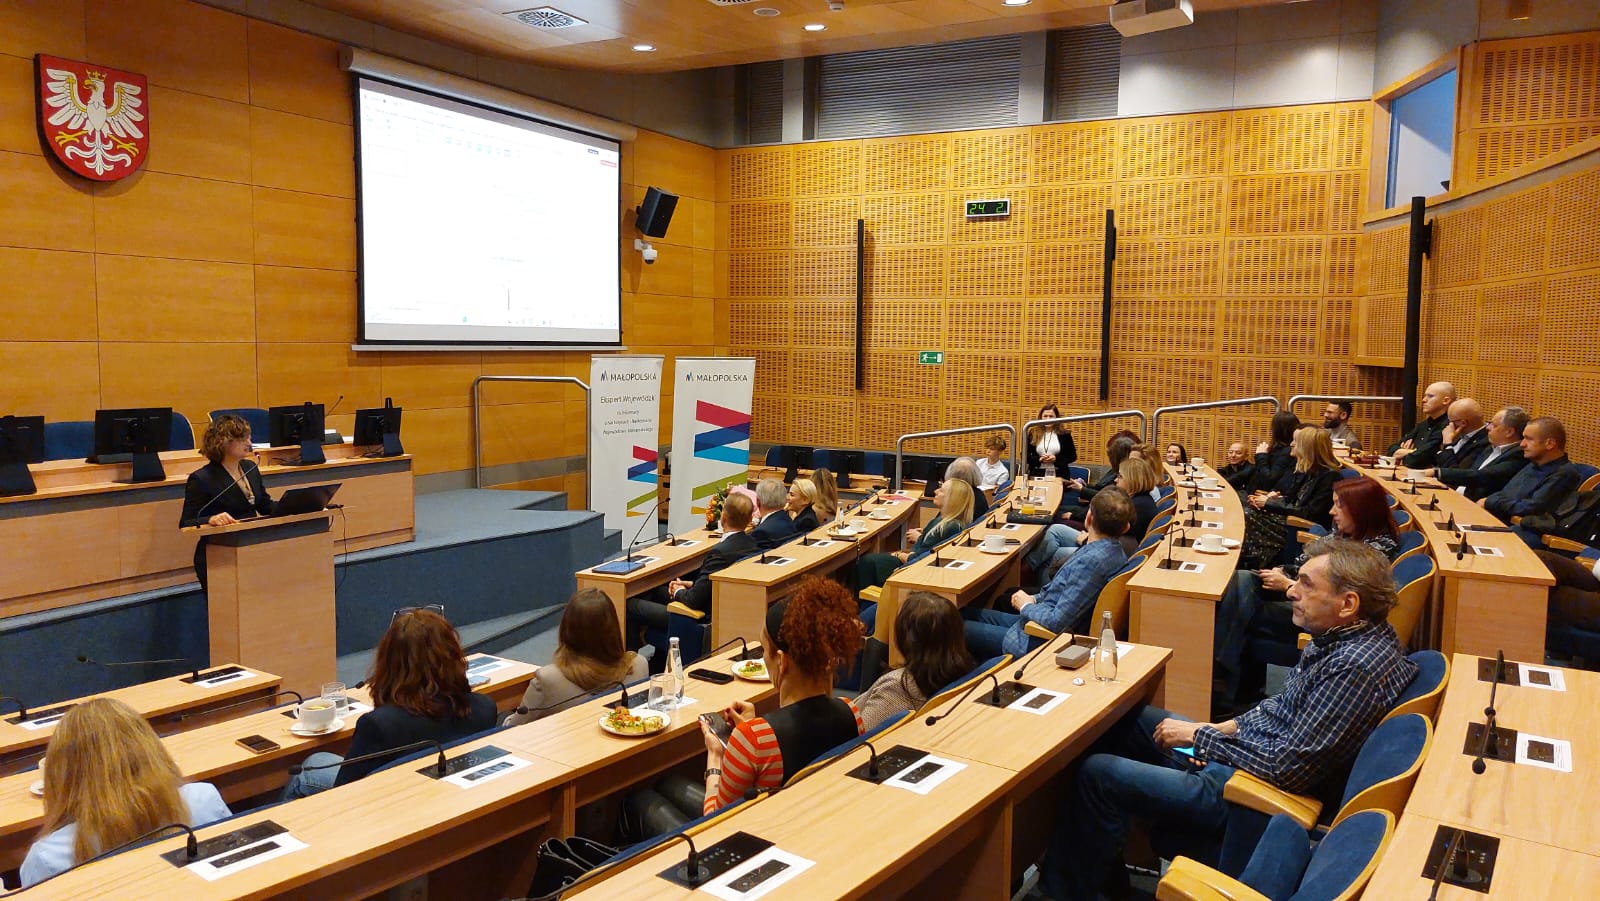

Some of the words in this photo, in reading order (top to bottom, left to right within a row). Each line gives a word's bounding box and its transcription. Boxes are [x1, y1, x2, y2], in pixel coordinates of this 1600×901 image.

[969, 203, 985, 215] 24
[610, 373, 656, 382] MAŁOPOLSKA
[696, 374, 748, 382] MAŁOPOLSKA
